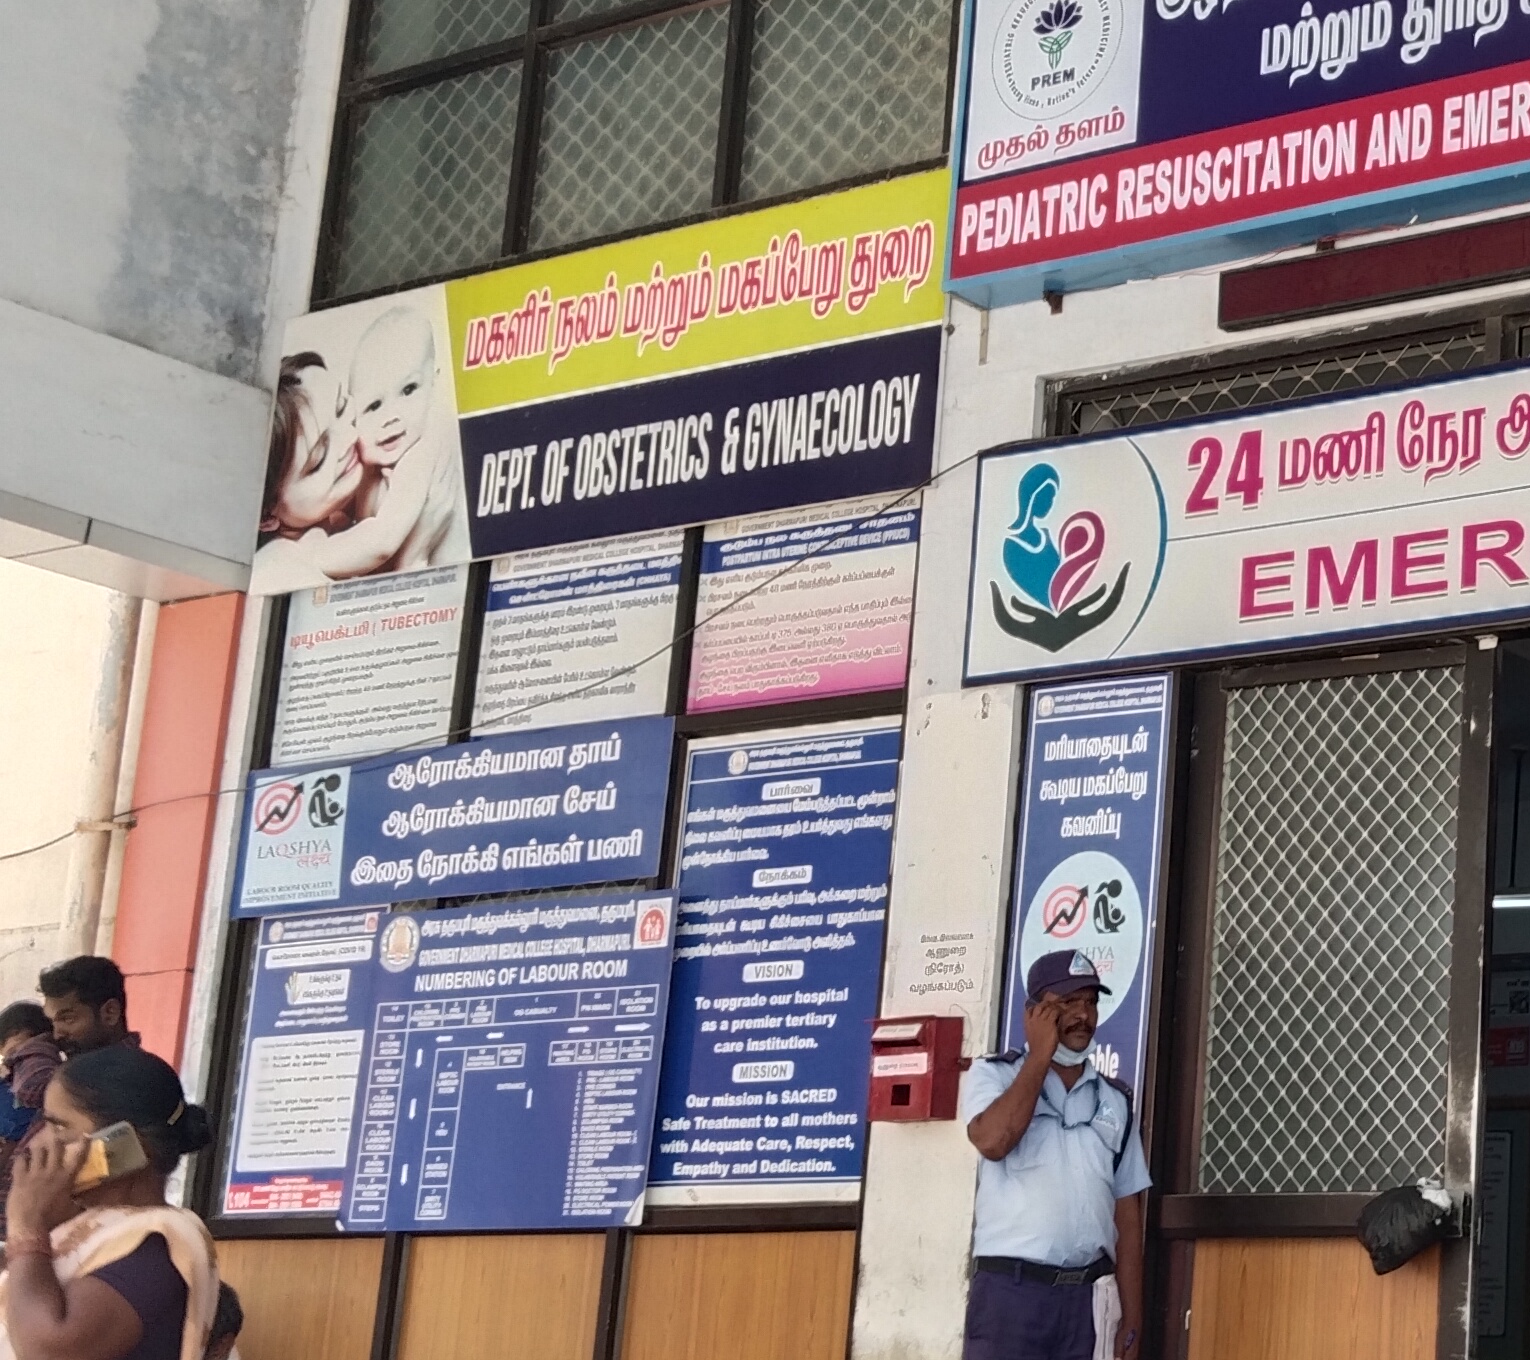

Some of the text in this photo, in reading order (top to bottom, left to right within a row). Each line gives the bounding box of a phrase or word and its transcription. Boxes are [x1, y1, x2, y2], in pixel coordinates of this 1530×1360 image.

[1030, 66, 1076, 91] PREM
[977, 106, 1126, 171] முதல் தளம்
[959, 173, 1107, 255] PEDIATRIC
[1115, 119, 1356, 222] RESUSCITATION
[1364, 103, 1431, 169] AND
[464, 222, 932, 368] மகளிர் நலம் மற்றும் மகப்பேறு துறை
[476, 373, 919, 517] DEPT. OF OBSTETRICS & GYNAECOLOGY
[1185, 429, 1263, 518] 24
[1278, 411, 1384, 485] மணி
[1396, 400, 1485, 485] நேர
[381, 608, 457, 631] TUBECTOMY
[387, 732, 621, 790] ஆரோக்கியமான தாய்
[1044, 726, 1149, 764] மரியாதையுடன்
[1040, 767, 1148, 805] கூடிய மகப்பேறு
[381, 780, 616, 838] ஆரோக்கியமான சேய்
[1061, 807, 1121, 839] கவனிப்பு
[257, 840, 332, 859] LAQSHYA
[350, 828, 643, 886] இதை நோக்கி எங்கள் பணி
[414, 959, 627, 991] NUMBERING OF LABOUR ROOM
[754, 964, 793, 978] VISION
[695, 988, 849, 1012] To upgrade our hospital
[739, 1064, 788, 1079] MISSION
